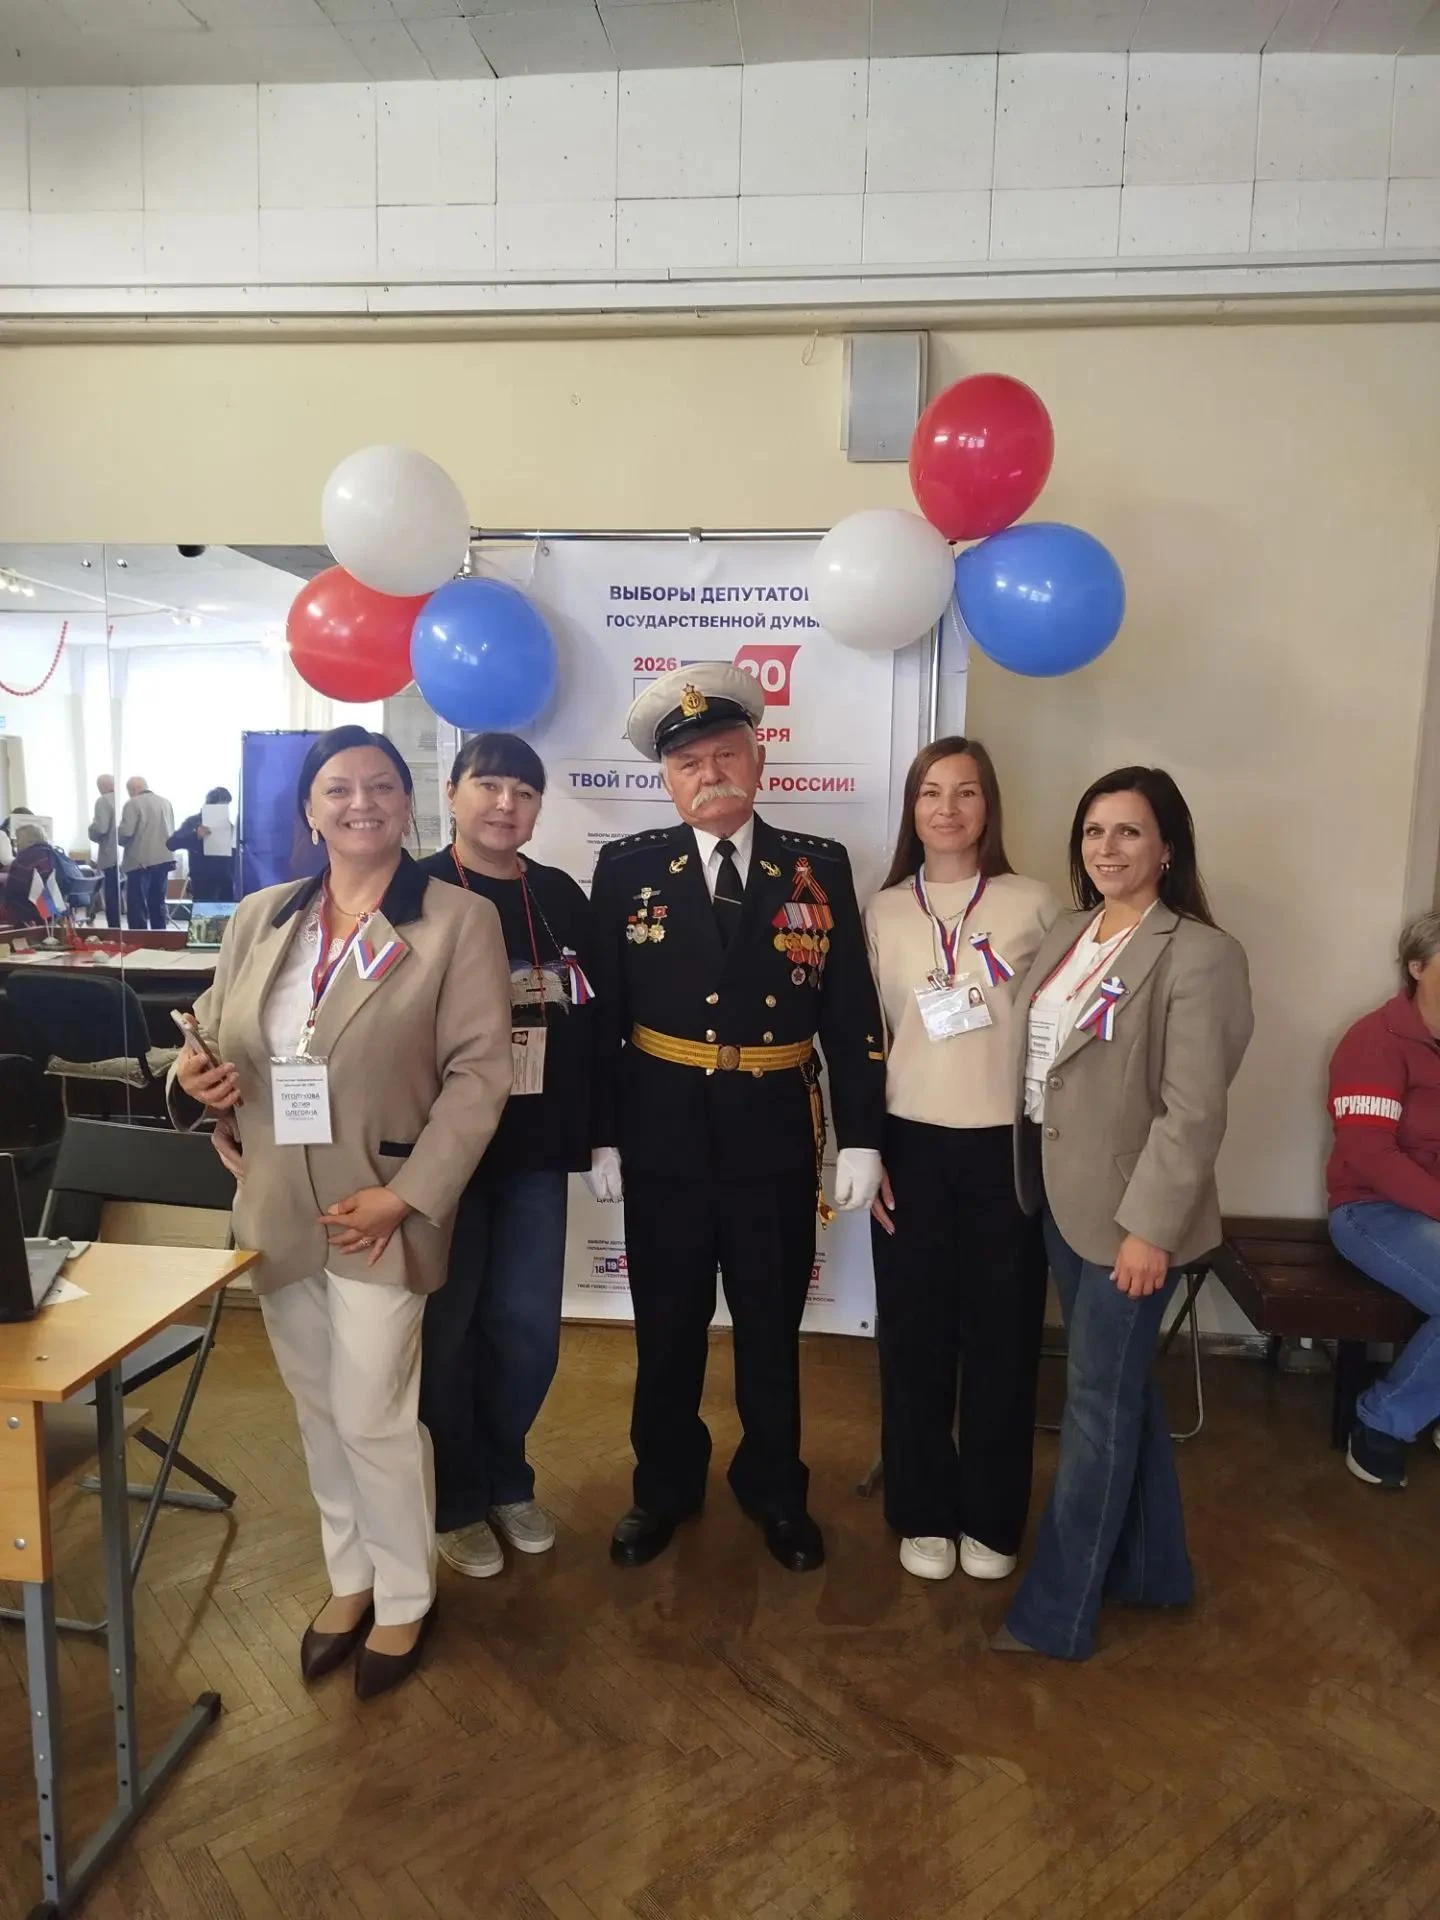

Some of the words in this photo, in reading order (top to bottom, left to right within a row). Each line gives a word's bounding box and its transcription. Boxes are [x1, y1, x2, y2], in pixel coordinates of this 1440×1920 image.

[610, 586, 695, 602] ВЫБОРЫ
[606, 612, 766, 629] ГОСУДАРСТВЕННОЙ
[634, 657, 677, 672] 2026
[569, 770, 620, 788] ТВОЙ
[625, 774, 662, 789] ГОЛ
[769, 777, 855, 792] РОССИИ!
[595, 1265, 605, 1274] 18
[606, 1261, 617, 1270] 19
